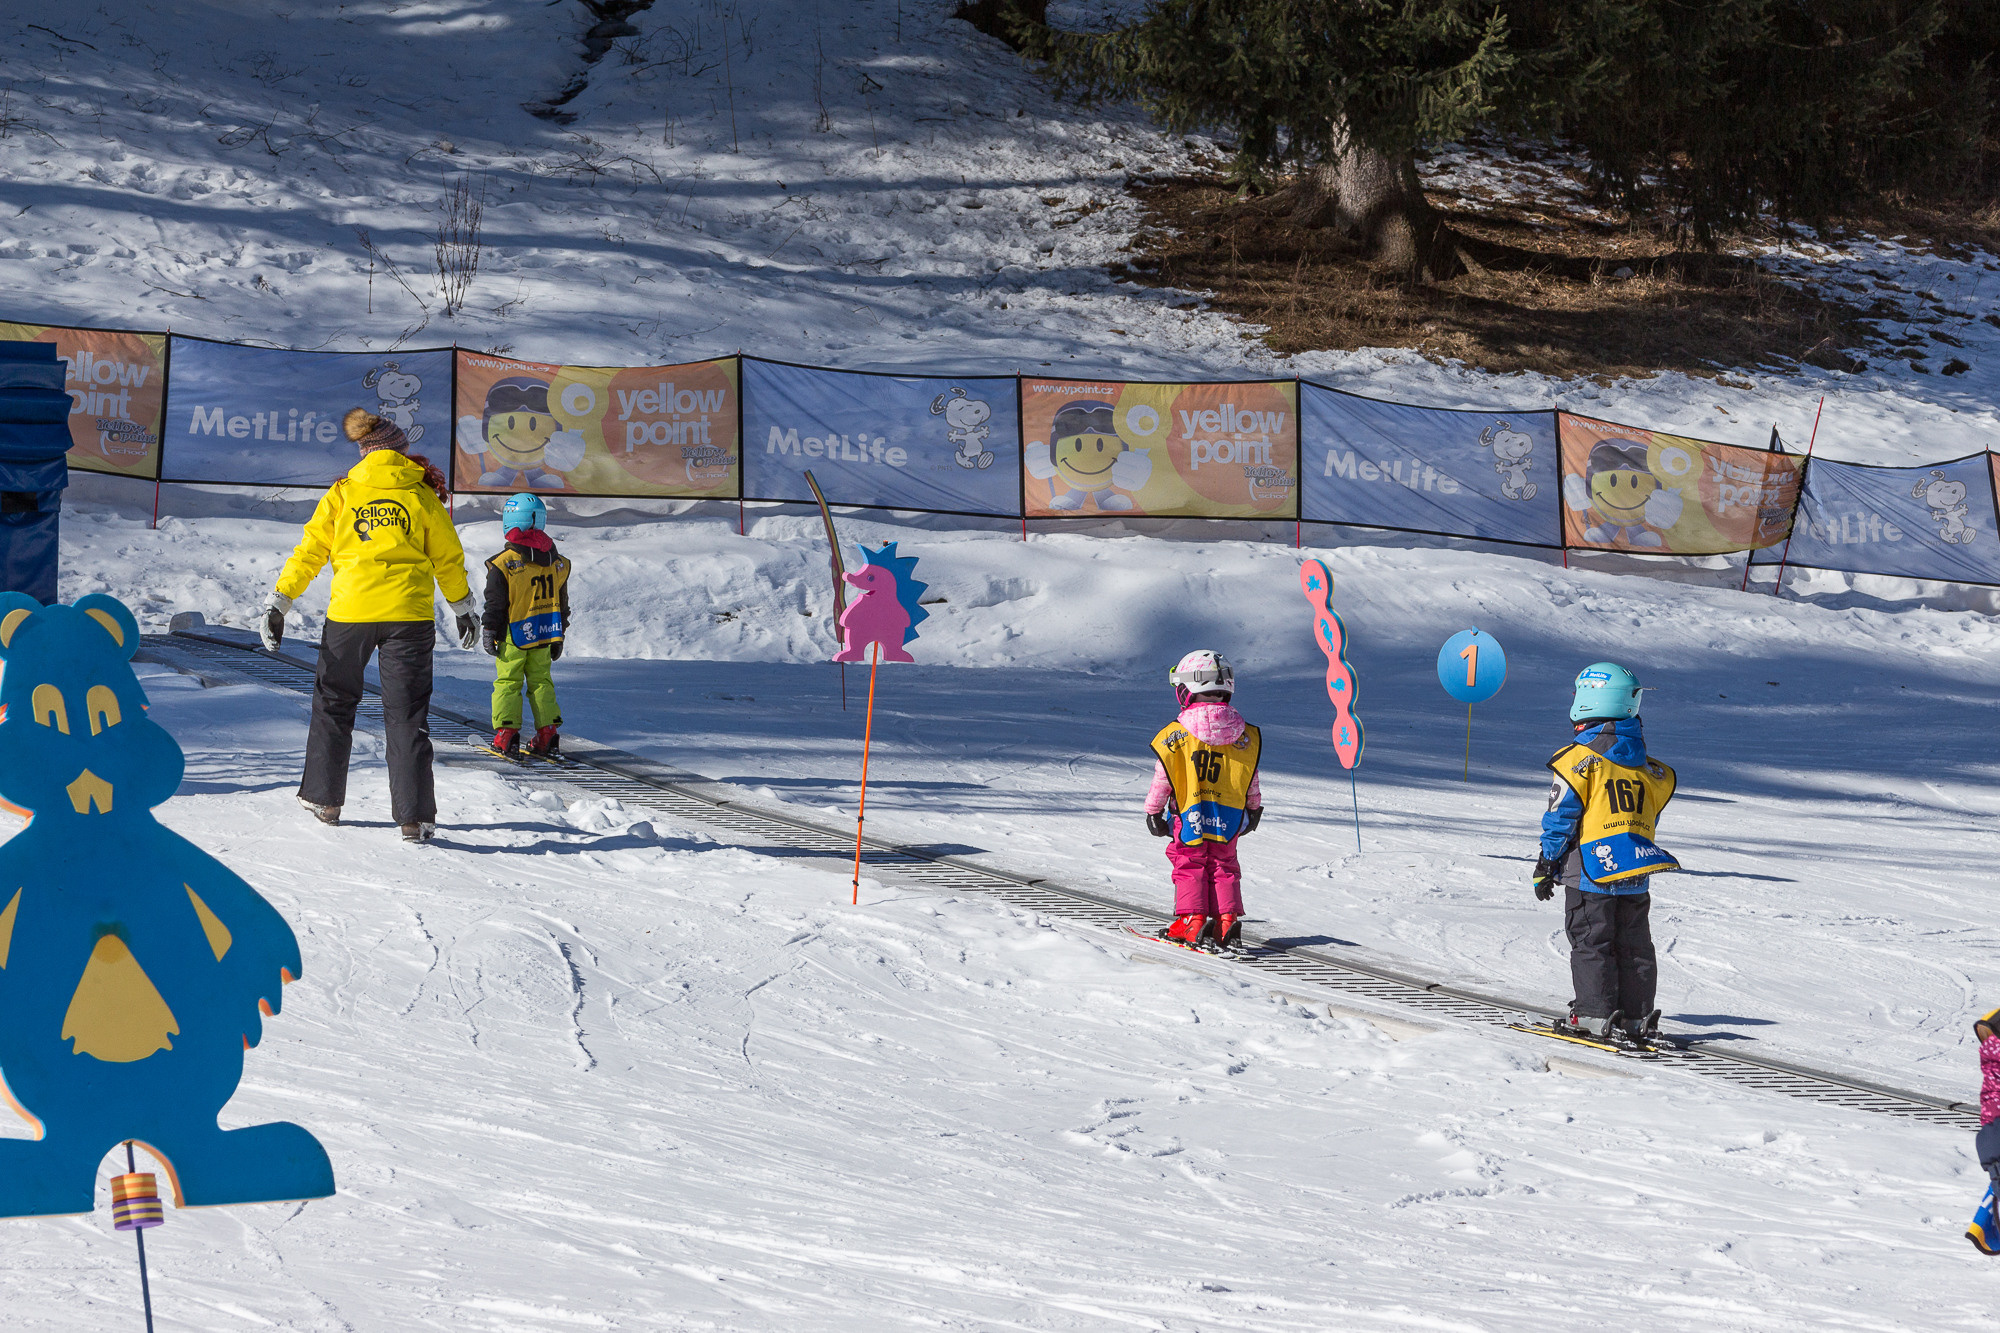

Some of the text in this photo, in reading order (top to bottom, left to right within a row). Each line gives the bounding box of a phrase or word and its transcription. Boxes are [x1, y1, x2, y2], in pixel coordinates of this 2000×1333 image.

[56, 350, 149, 388] ellow
[65, 384, 131, 419] oint
[616, 382, 726, 421] yellow
[1032, 384, 1114, 396] www.ypoint.cz
[188, 405, 338, 443] MetLife
[624, 414, 712, 453] point
[1178, 403, 1286, 440] yellow
[766, 425, 909, 468] MetLife
[1190, 433, 1273, 471] point
[1323, 449, 1460, 495] MetLife
[351, 505, 402, 519] Yellow
[1717, 483, 1783, 513] point
[370, 516, 408, 531] point
[529, 573, 554, 601] 211
[1459, 644, 1478, 687] 1
[1604, 778, 1646, 815] 167
